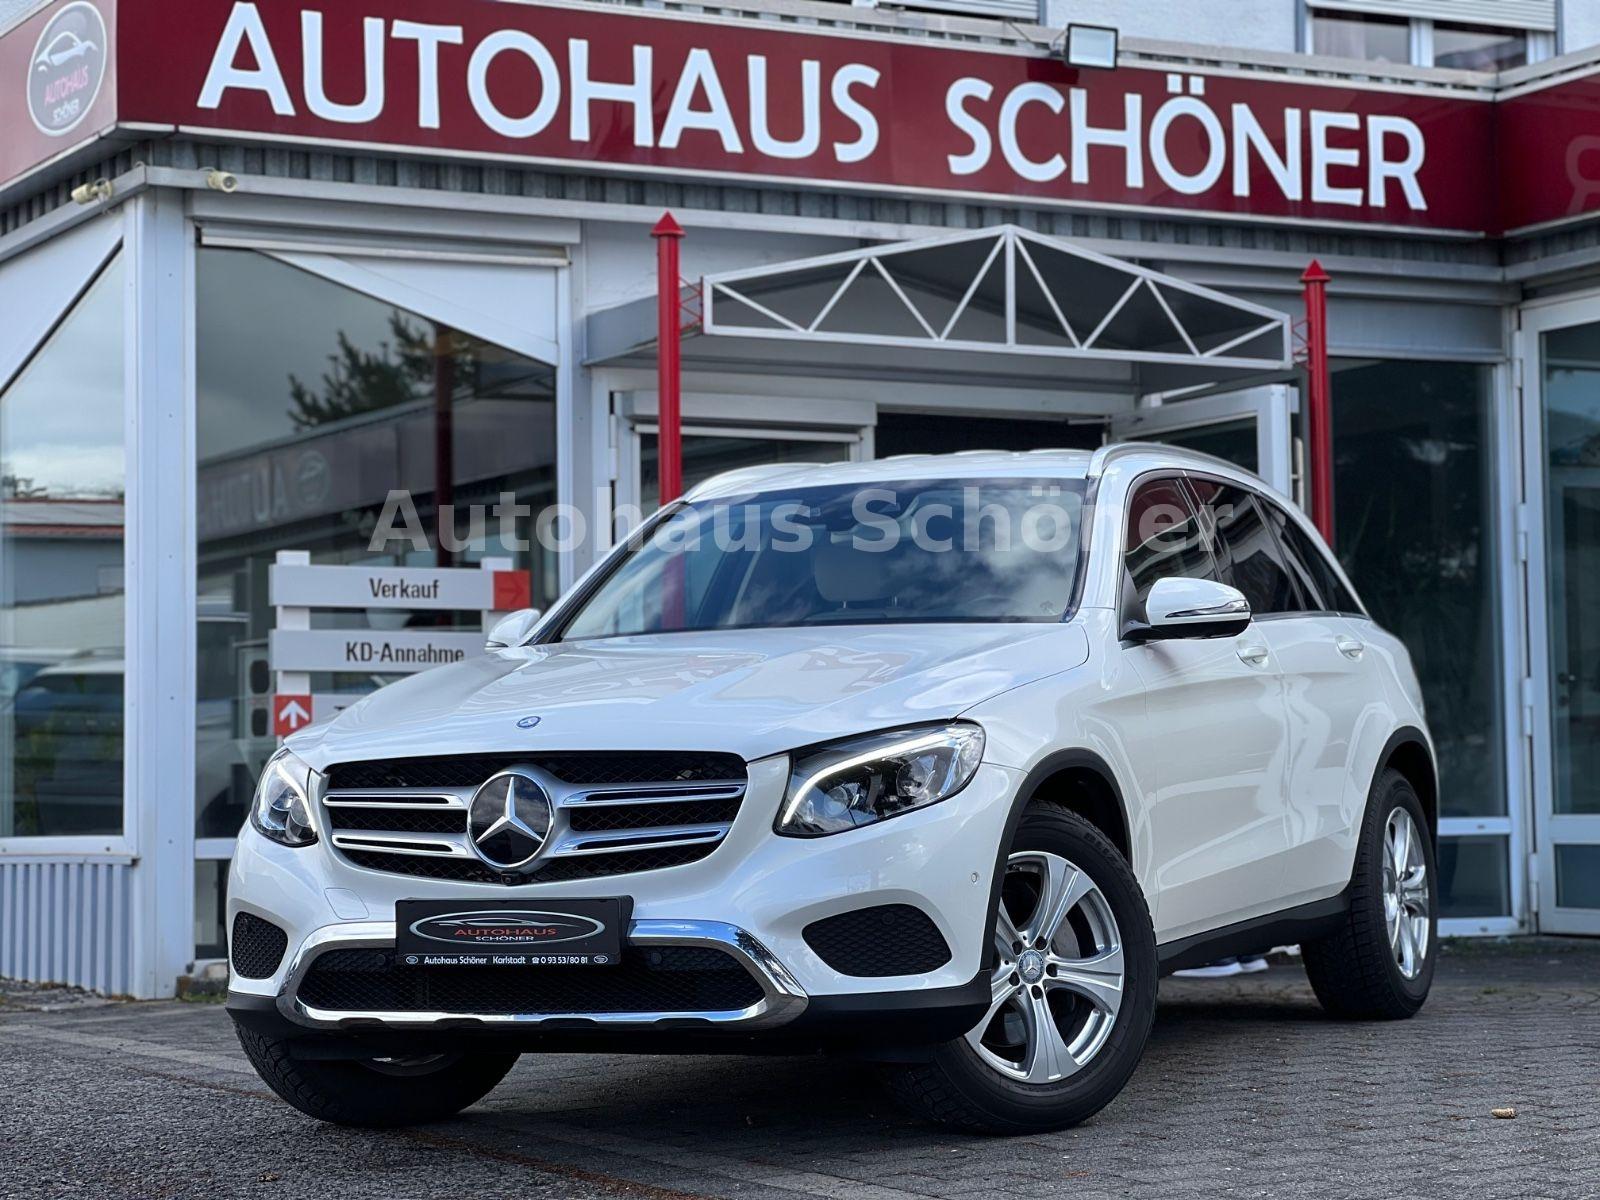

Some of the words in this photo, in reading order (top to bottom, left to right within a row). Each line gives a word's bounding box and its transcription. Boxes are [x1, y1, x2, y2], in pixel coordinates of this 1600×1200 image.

[197, 1, 881, 163] AUTOHAUS
[945, 74, 1428, 211] SCHÖNER
[369, 577, 440, 599] Verkauf
[345, 641, 465, 664] KD-Annahme
[454, 928, 557, 936] AUTOHAUS
[424, 956, 458, 964] Autohaus
[459, 956, 487, 964] Schöner
[493, 956, 526, 964] Karlstadt
